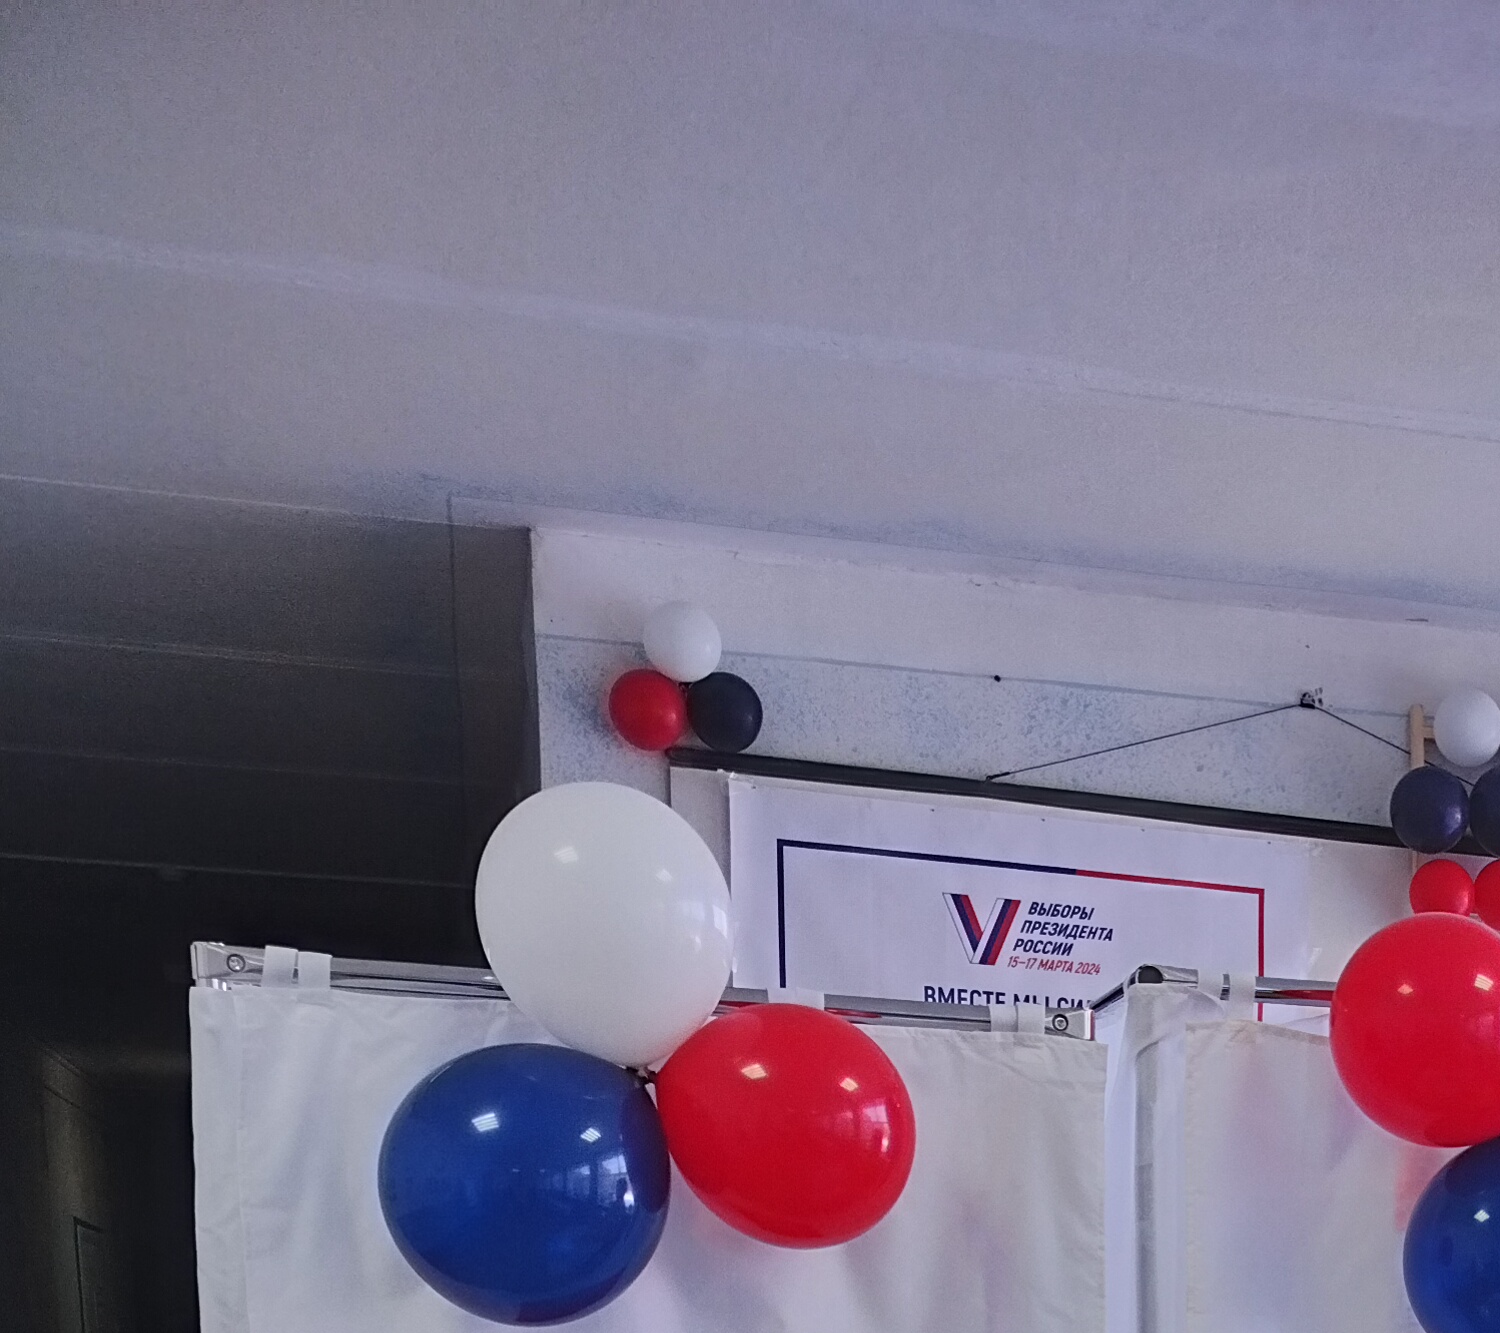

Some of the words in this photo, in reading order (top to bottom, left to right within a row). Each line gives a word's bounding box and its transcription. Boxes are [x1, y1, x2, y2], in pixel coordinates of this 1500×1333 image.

[1028, 902, 1095, 921] ВЫБОРЫ
[1020, 920, 1114, 942] ПРЕЗИДЕНТА
[1013, 938, 1074, 957] РОССИИ
[1038, 959, 1074, 973] МАРТА
[1075, 962, 1101, 975] 2024
[924, 986, 1006, 1005] ВМЕСТЕ
